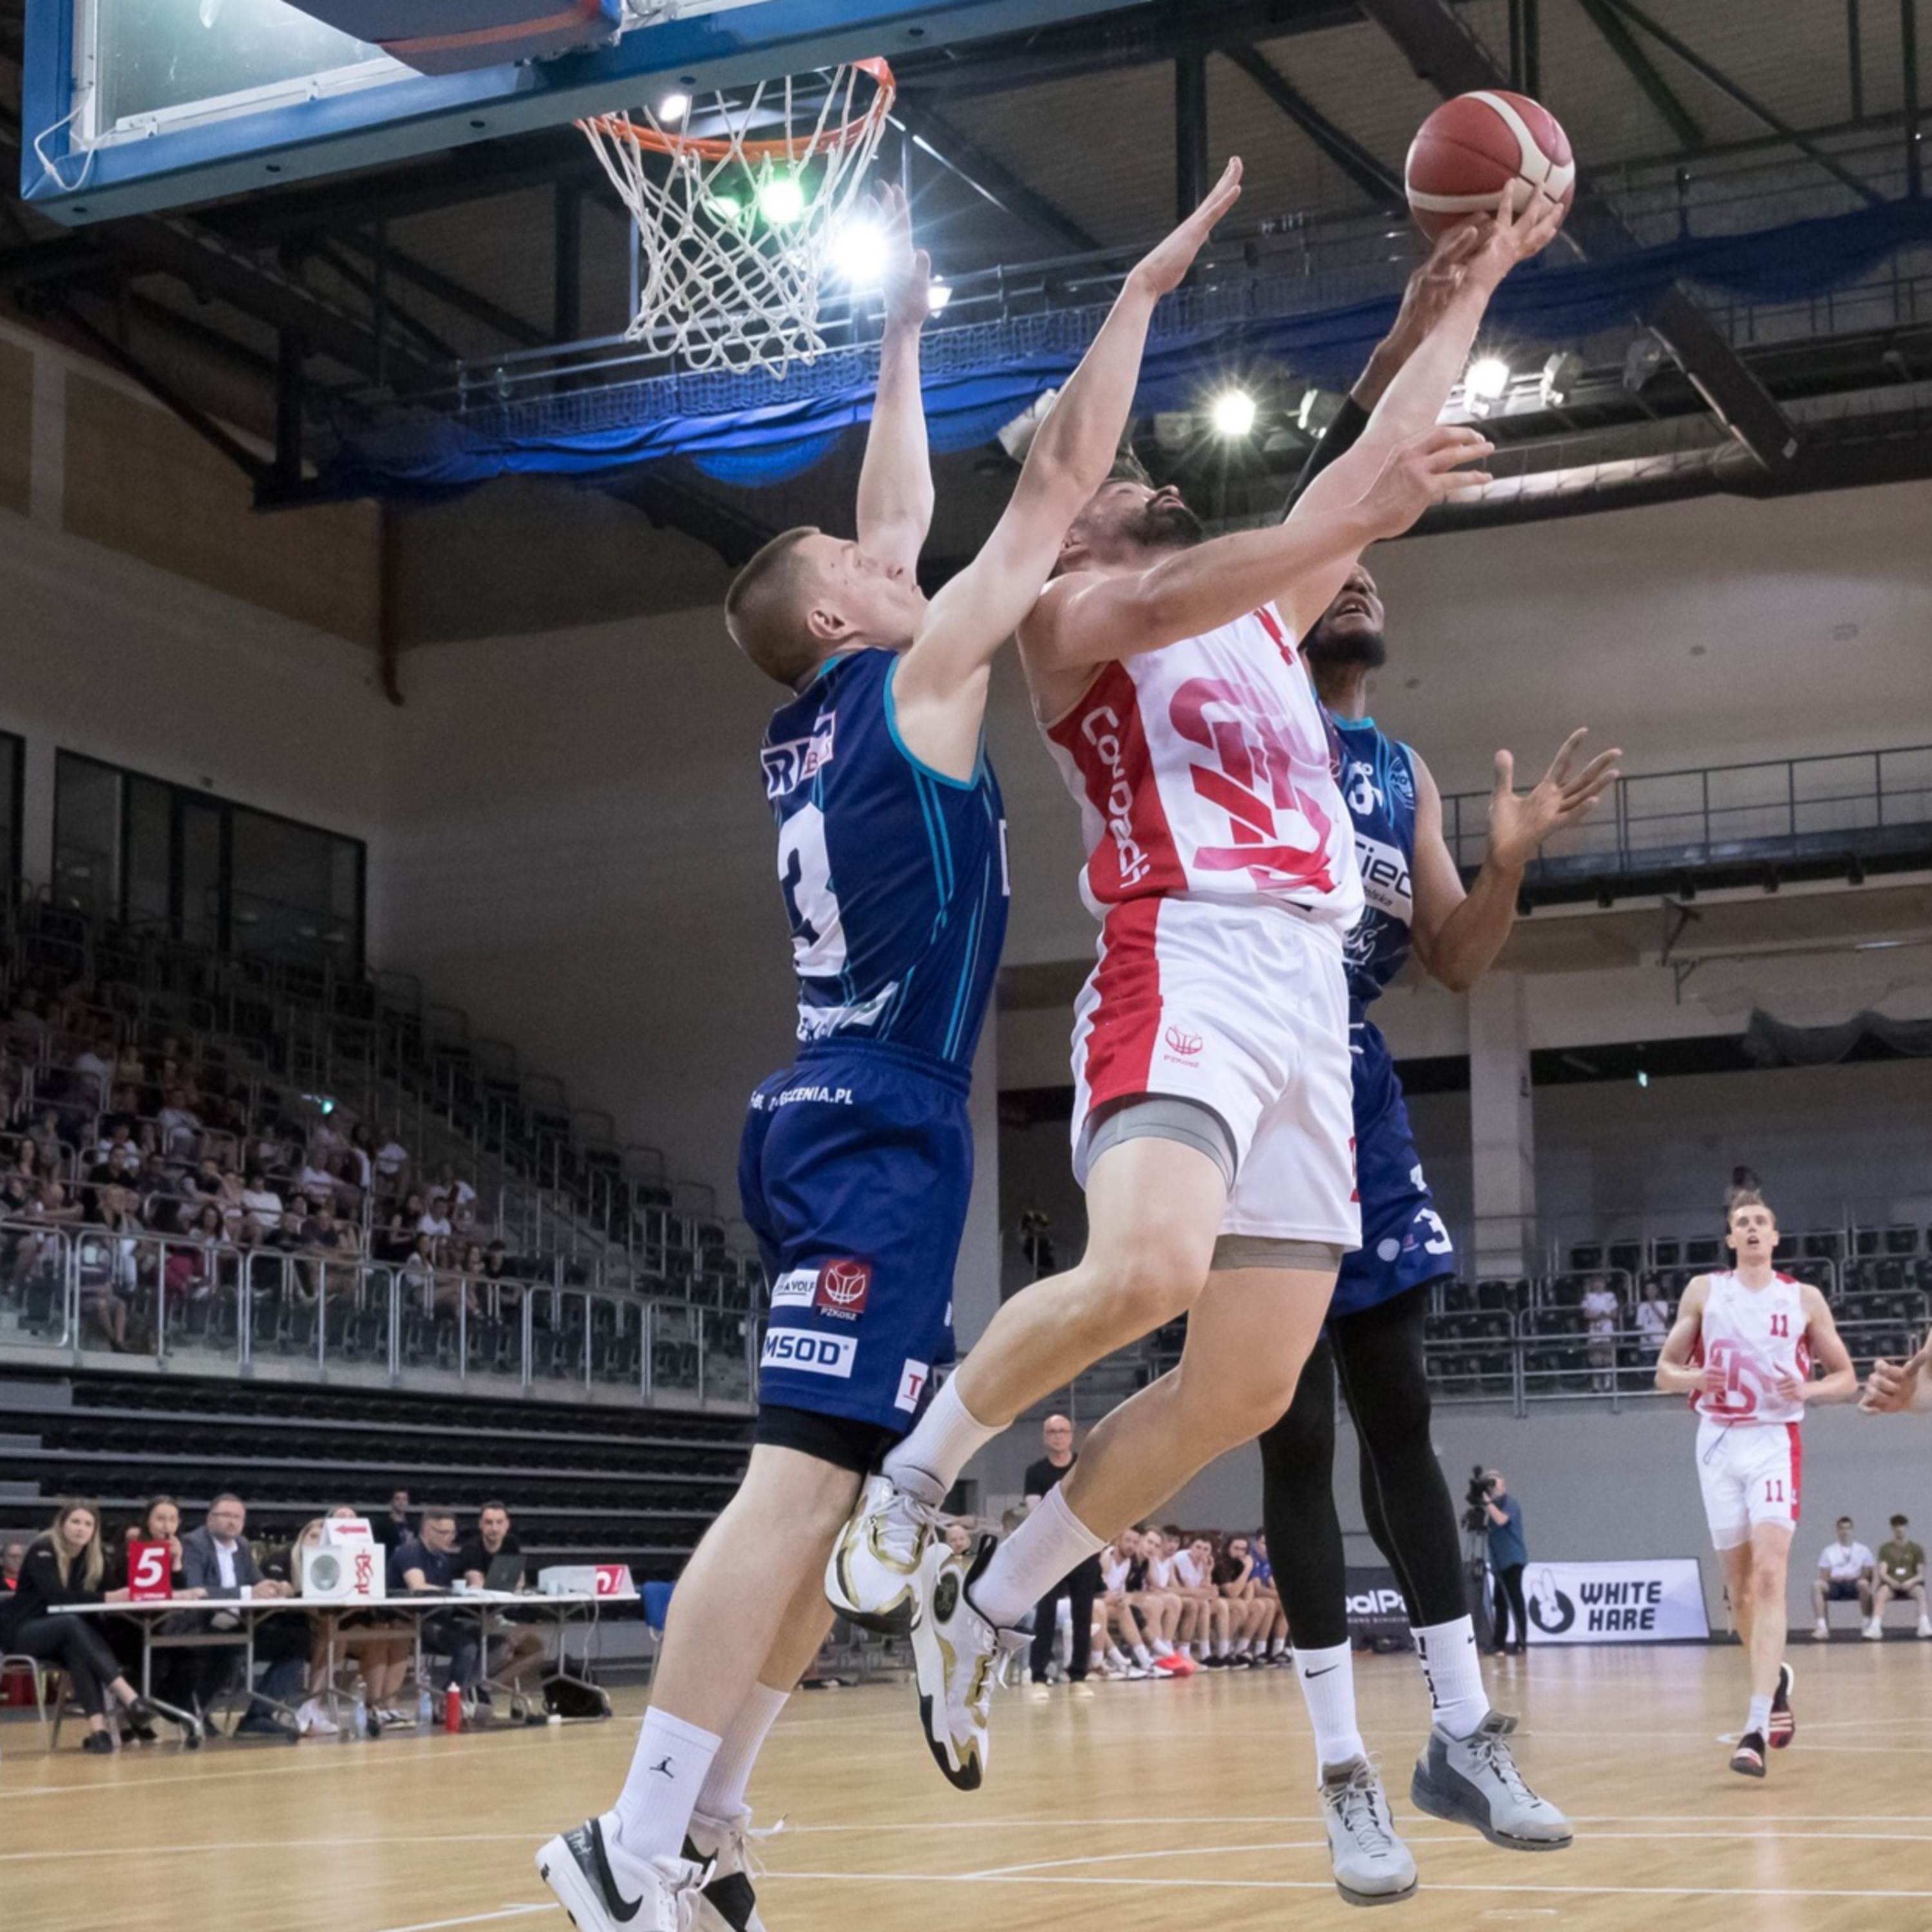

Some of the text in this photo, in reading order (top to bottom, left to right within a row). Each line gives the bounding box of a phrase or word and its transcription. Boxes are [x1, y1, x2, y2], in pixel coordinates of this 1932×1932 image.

[1770, 1314, 1788, 1338] 11
[1765, 1479, 1783, 1502] 11
[134, 1547, 166, 1588] 5
[1580, 1580, 1662, 1605] WHITE
[1587, 1607, 1656, 1632] HARE
